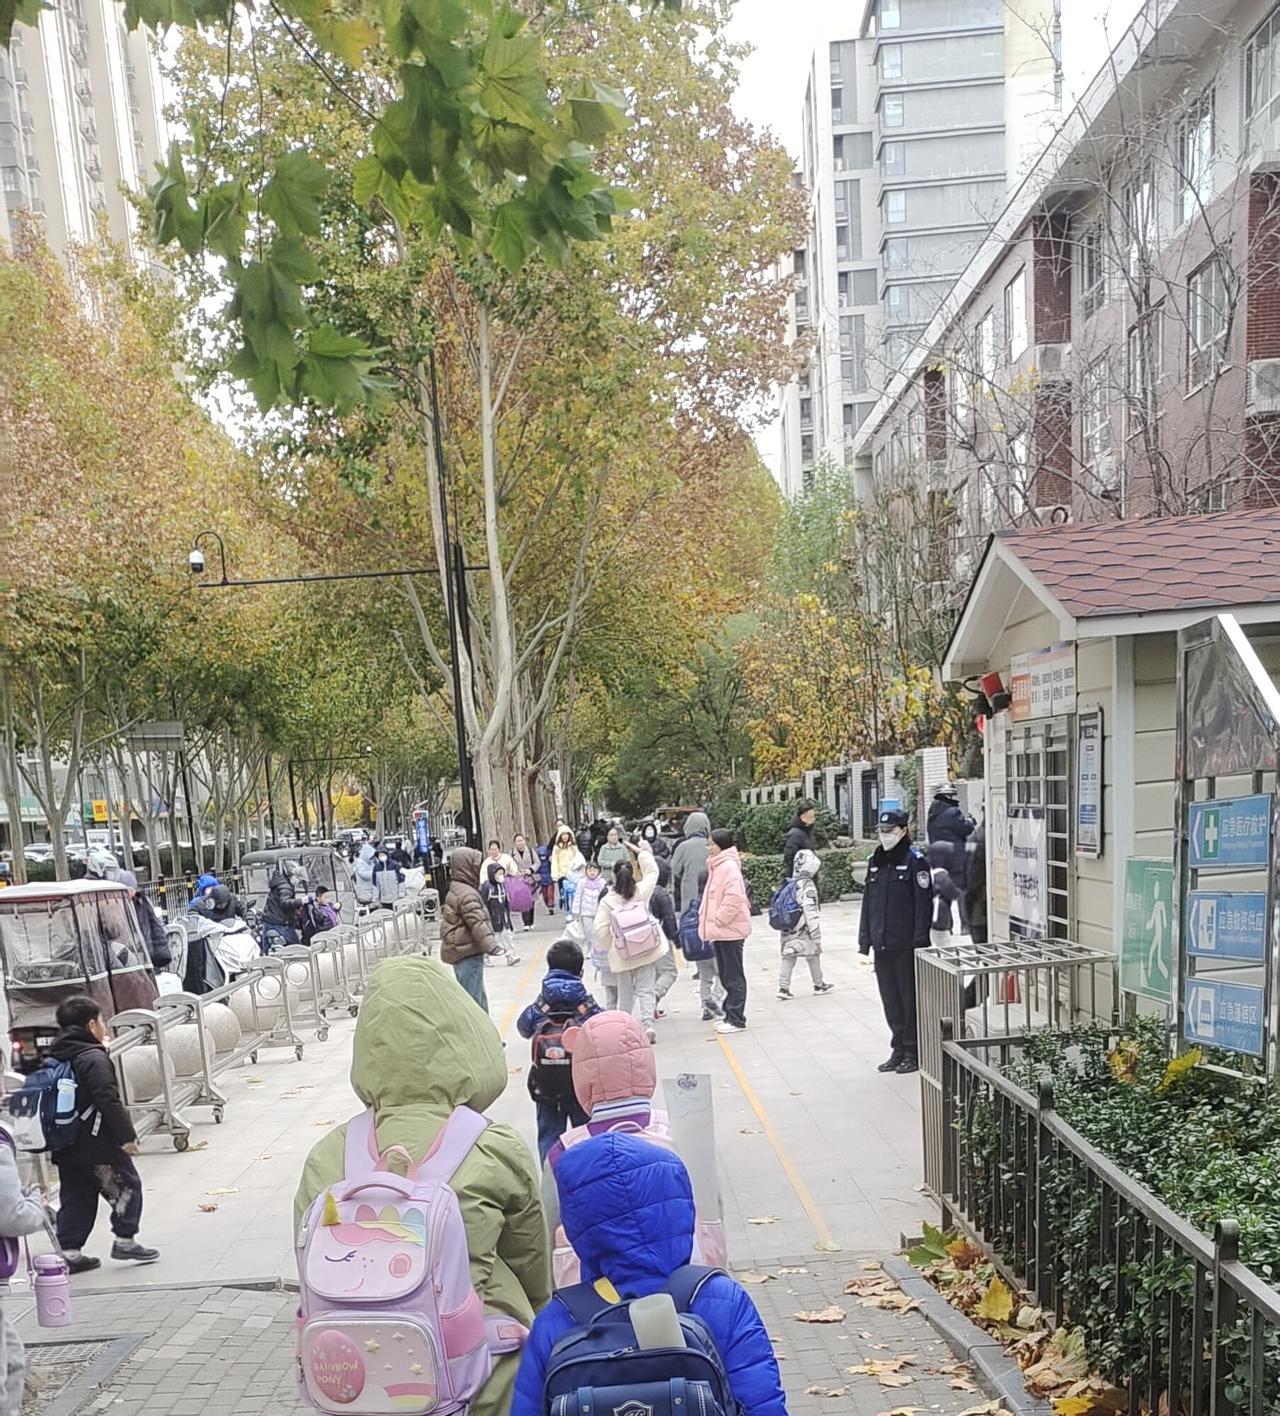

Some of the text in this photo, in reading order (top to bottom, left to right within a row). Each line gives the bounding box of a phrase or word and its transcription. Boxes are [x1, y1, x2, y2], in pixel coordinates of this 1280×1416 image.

[1218, 910, 1264, 931] 应急物资供应
[316, 1374, 342, 1386] PONY
